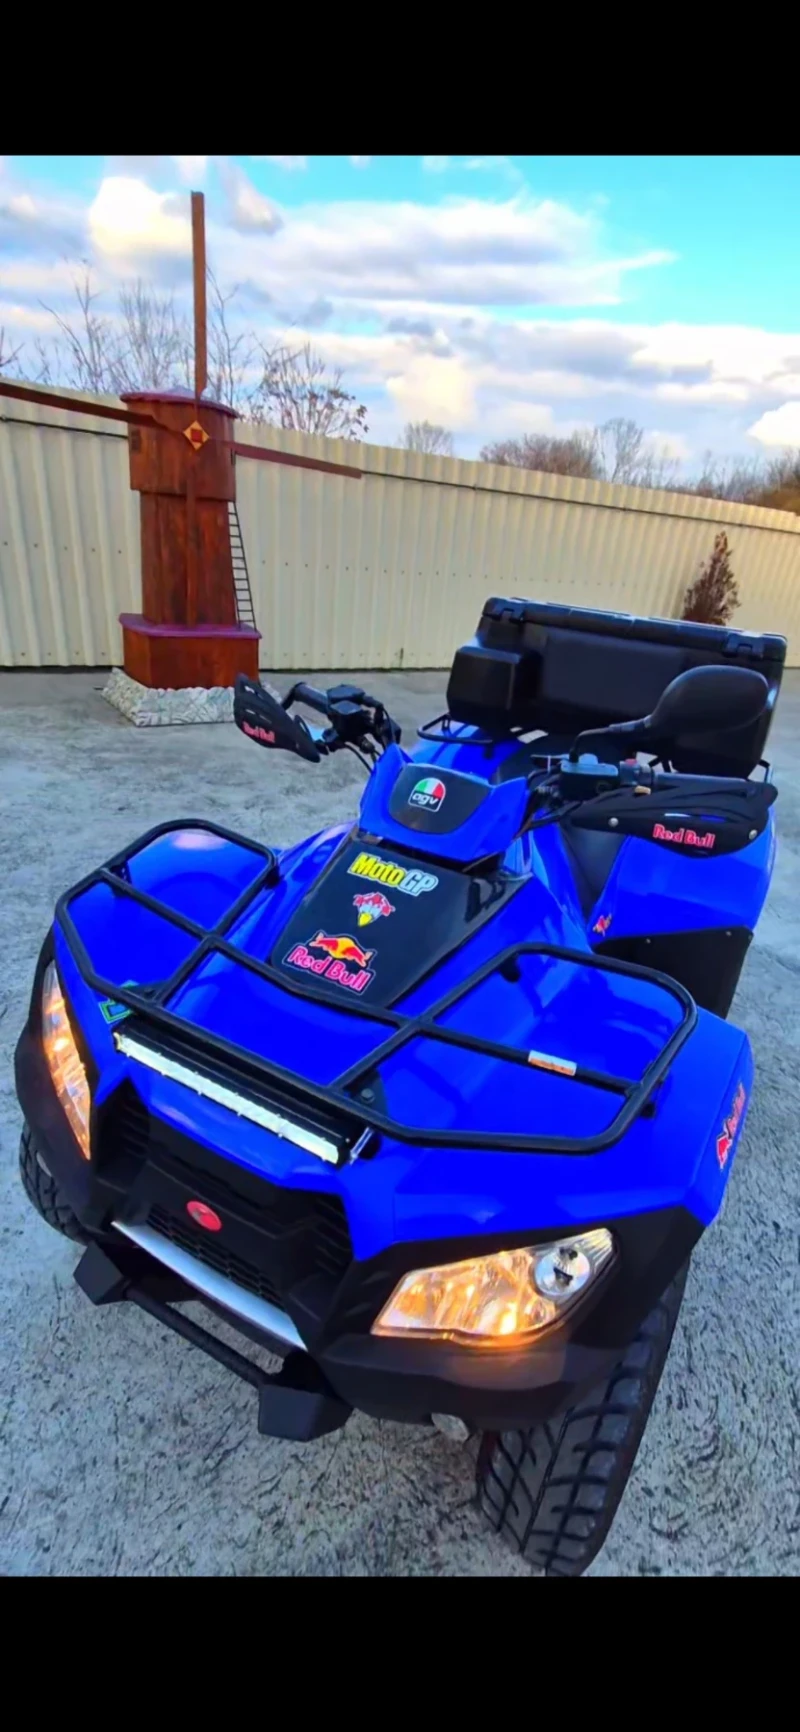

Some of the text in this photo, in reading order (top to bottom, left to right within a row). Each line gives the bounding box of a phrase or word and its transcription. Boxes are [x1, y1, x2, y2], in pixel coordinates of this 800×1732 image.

[411, 793, 439, 806] agv
[653, 824, 716, 848] Red Bull
[348, 852, 438, 896] MotoGP
[288, 946, 371, 990] Red Bull
